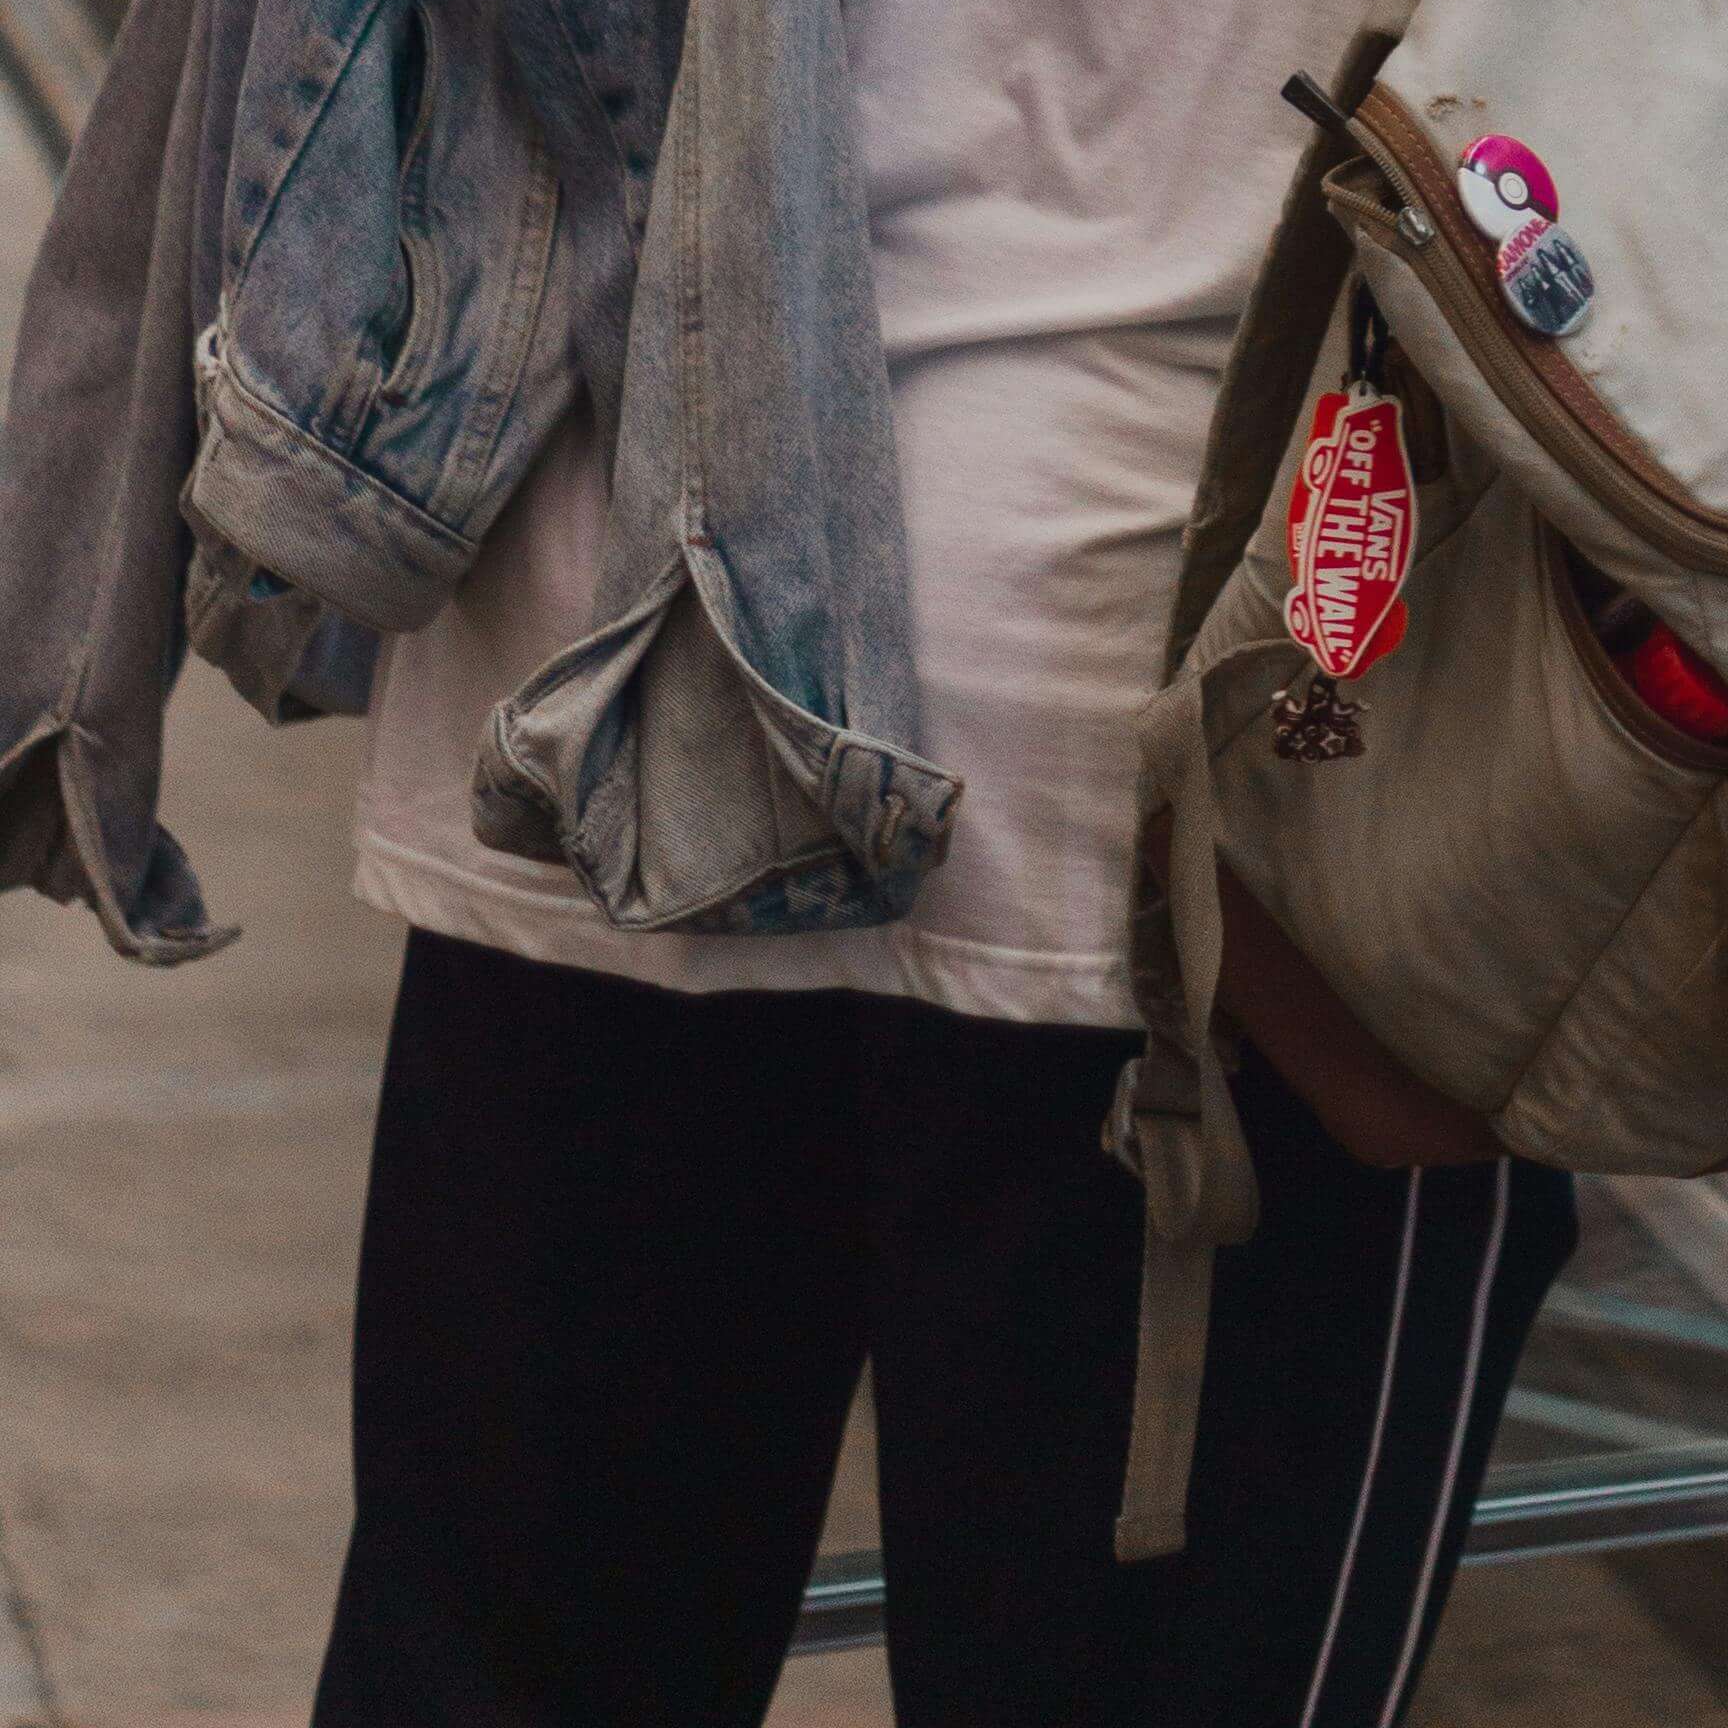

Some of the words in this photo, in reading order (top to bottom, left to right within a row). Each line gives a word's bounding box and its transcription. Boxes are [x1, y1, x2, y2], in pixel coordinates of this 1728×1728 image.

[1340, 419, 1382, 488] "OFF
[1317, 495, 1368, 561] THE
[1362, 488, 1405, 581] VANS
[1316, 567, 1360, 663] WALL"
